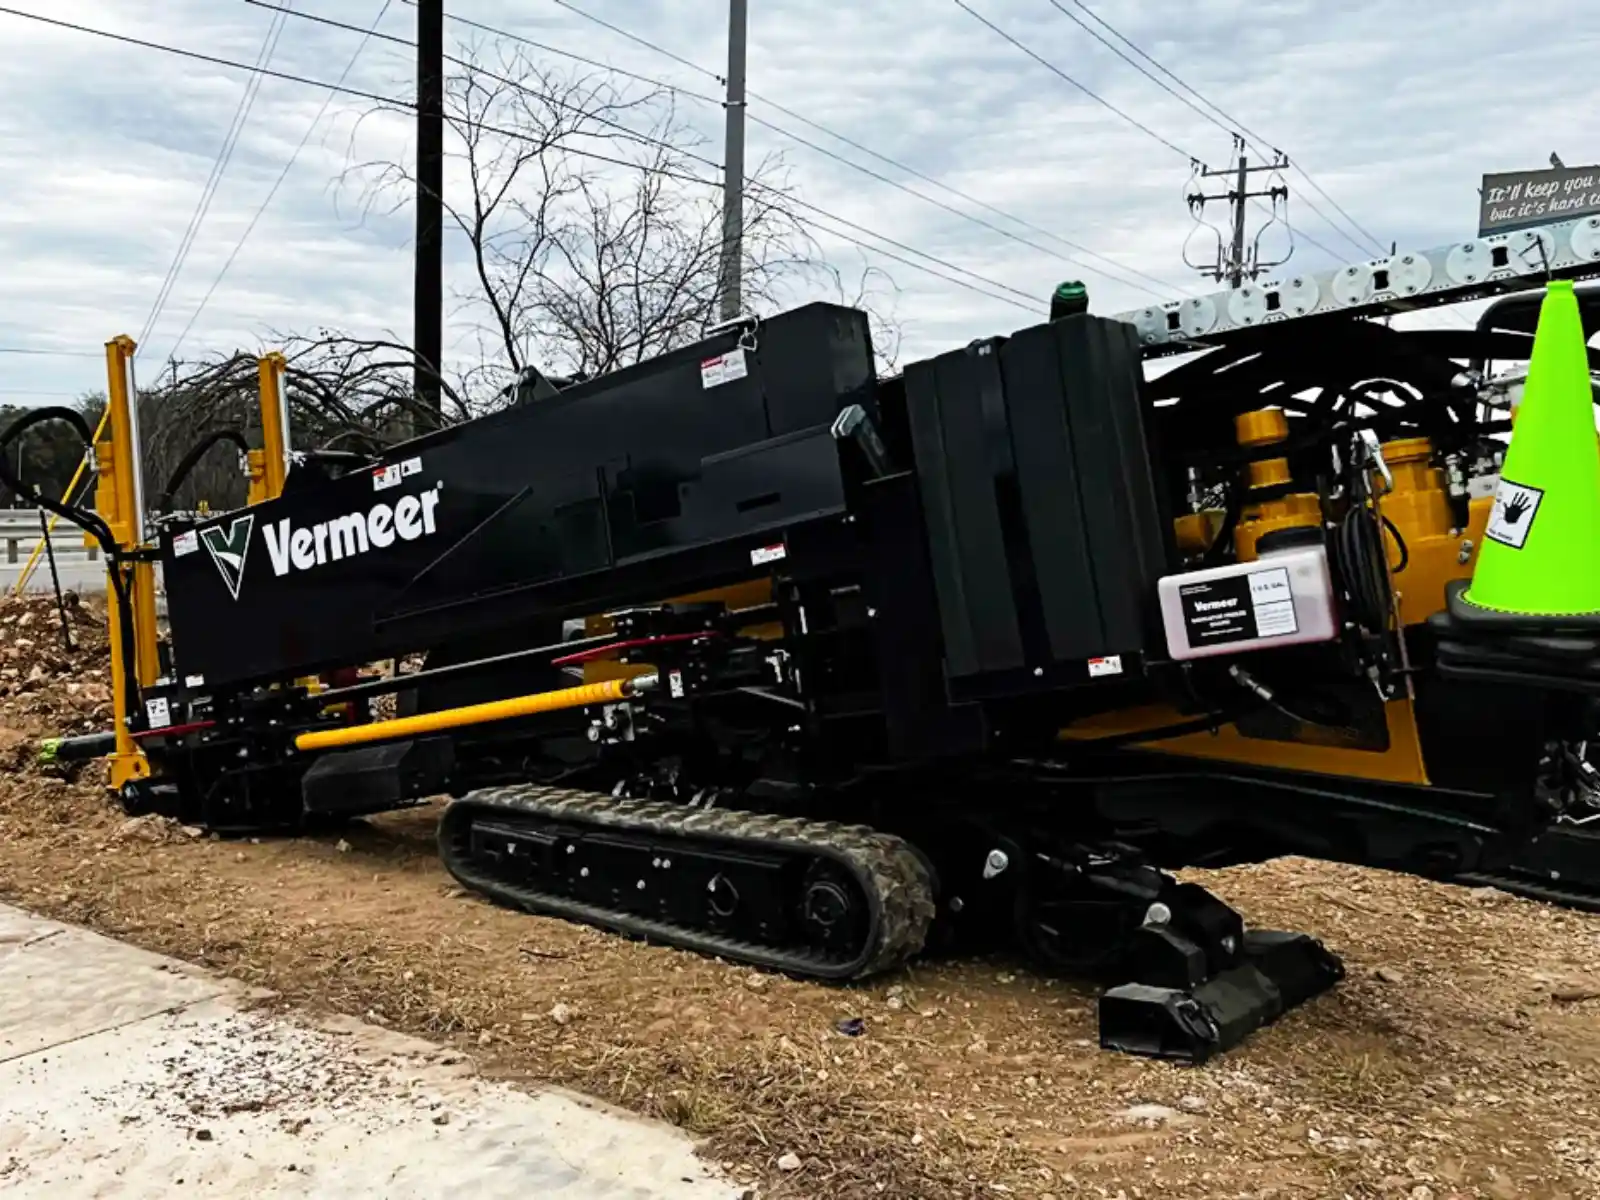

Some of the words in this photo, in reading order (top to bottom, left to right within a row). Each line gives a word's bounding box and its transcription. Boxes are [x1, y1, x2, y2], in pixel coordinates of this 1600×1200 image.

[1487, 182, 1522, 204] It'll
[1524, 181, 1560, 198] keep
[1564, 176, 1593, 195] you
[1489, 206, 1516, 222] but
[1518, 201, 1546, 217] it's
[1549, 193, 1586, 212] hard
[262, 487, 440, 577] Vermeer
[1194, 598, 1238, 612] Vermeer
